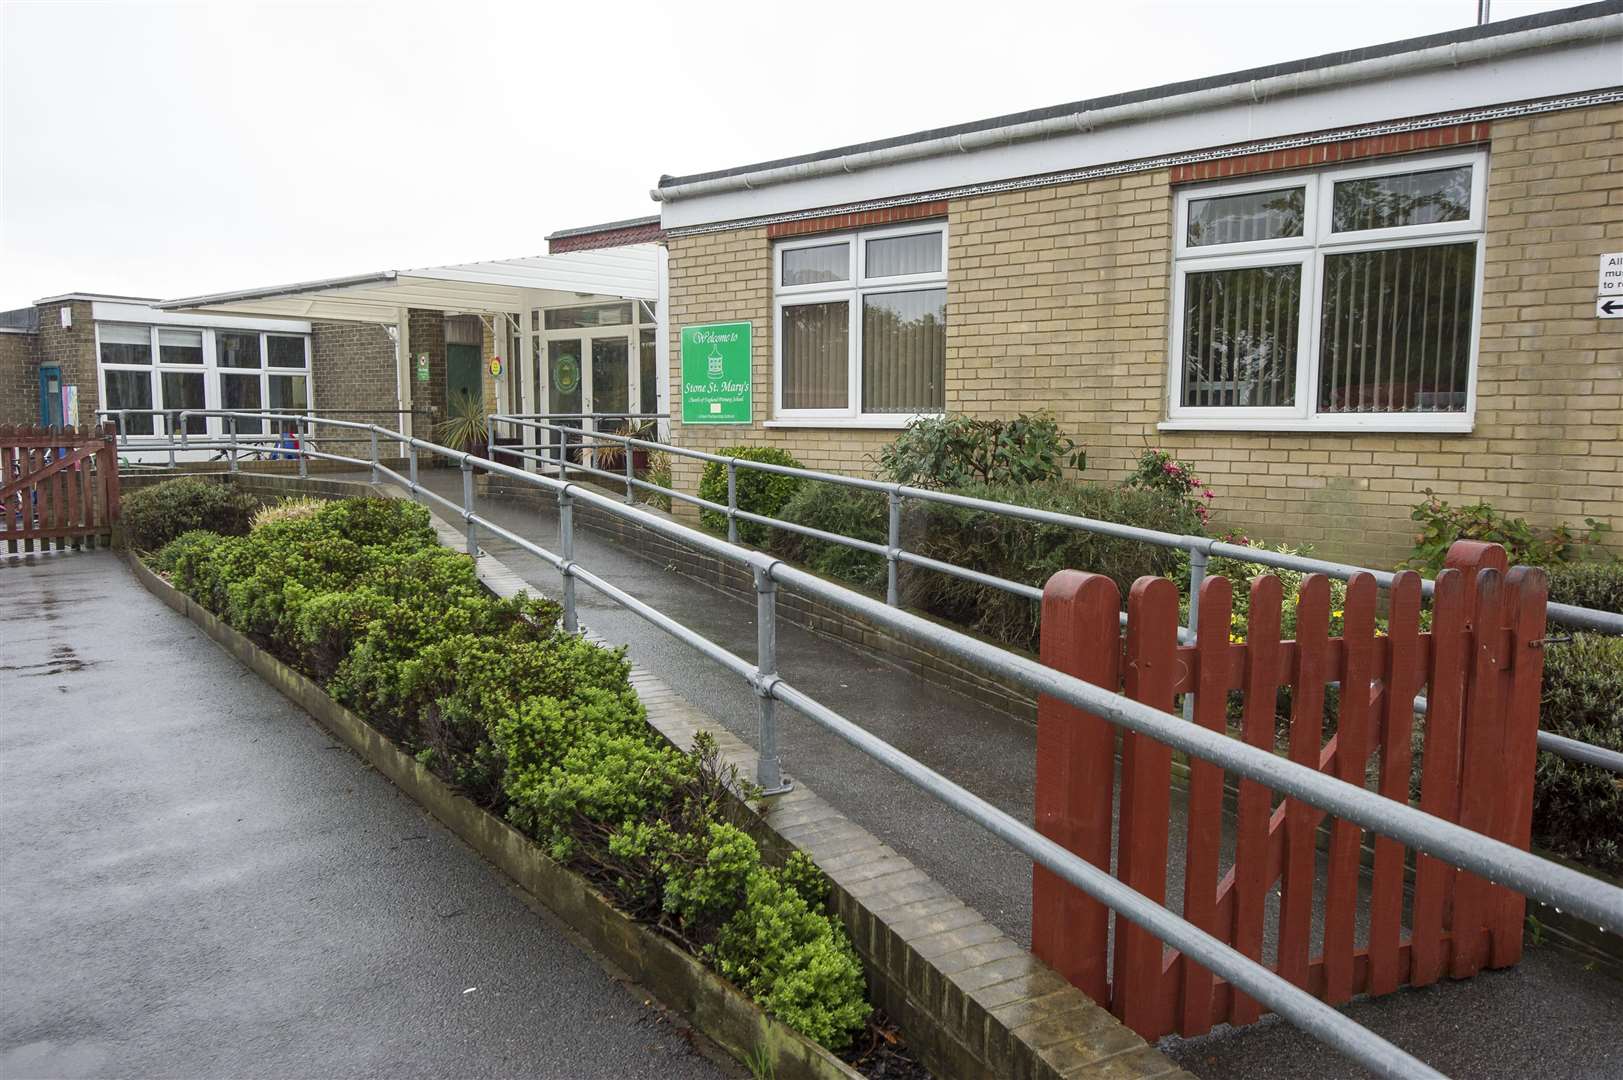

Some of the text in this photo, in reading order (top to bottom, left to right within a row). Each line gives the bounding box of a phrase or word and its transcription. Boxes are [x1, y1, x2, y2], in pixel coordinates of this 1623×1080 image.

[1608, 257, 1622, 266] All
[693, 331, 738, 344] Welcome to
[684, 380, 749, 395] Stone St. Mary's
